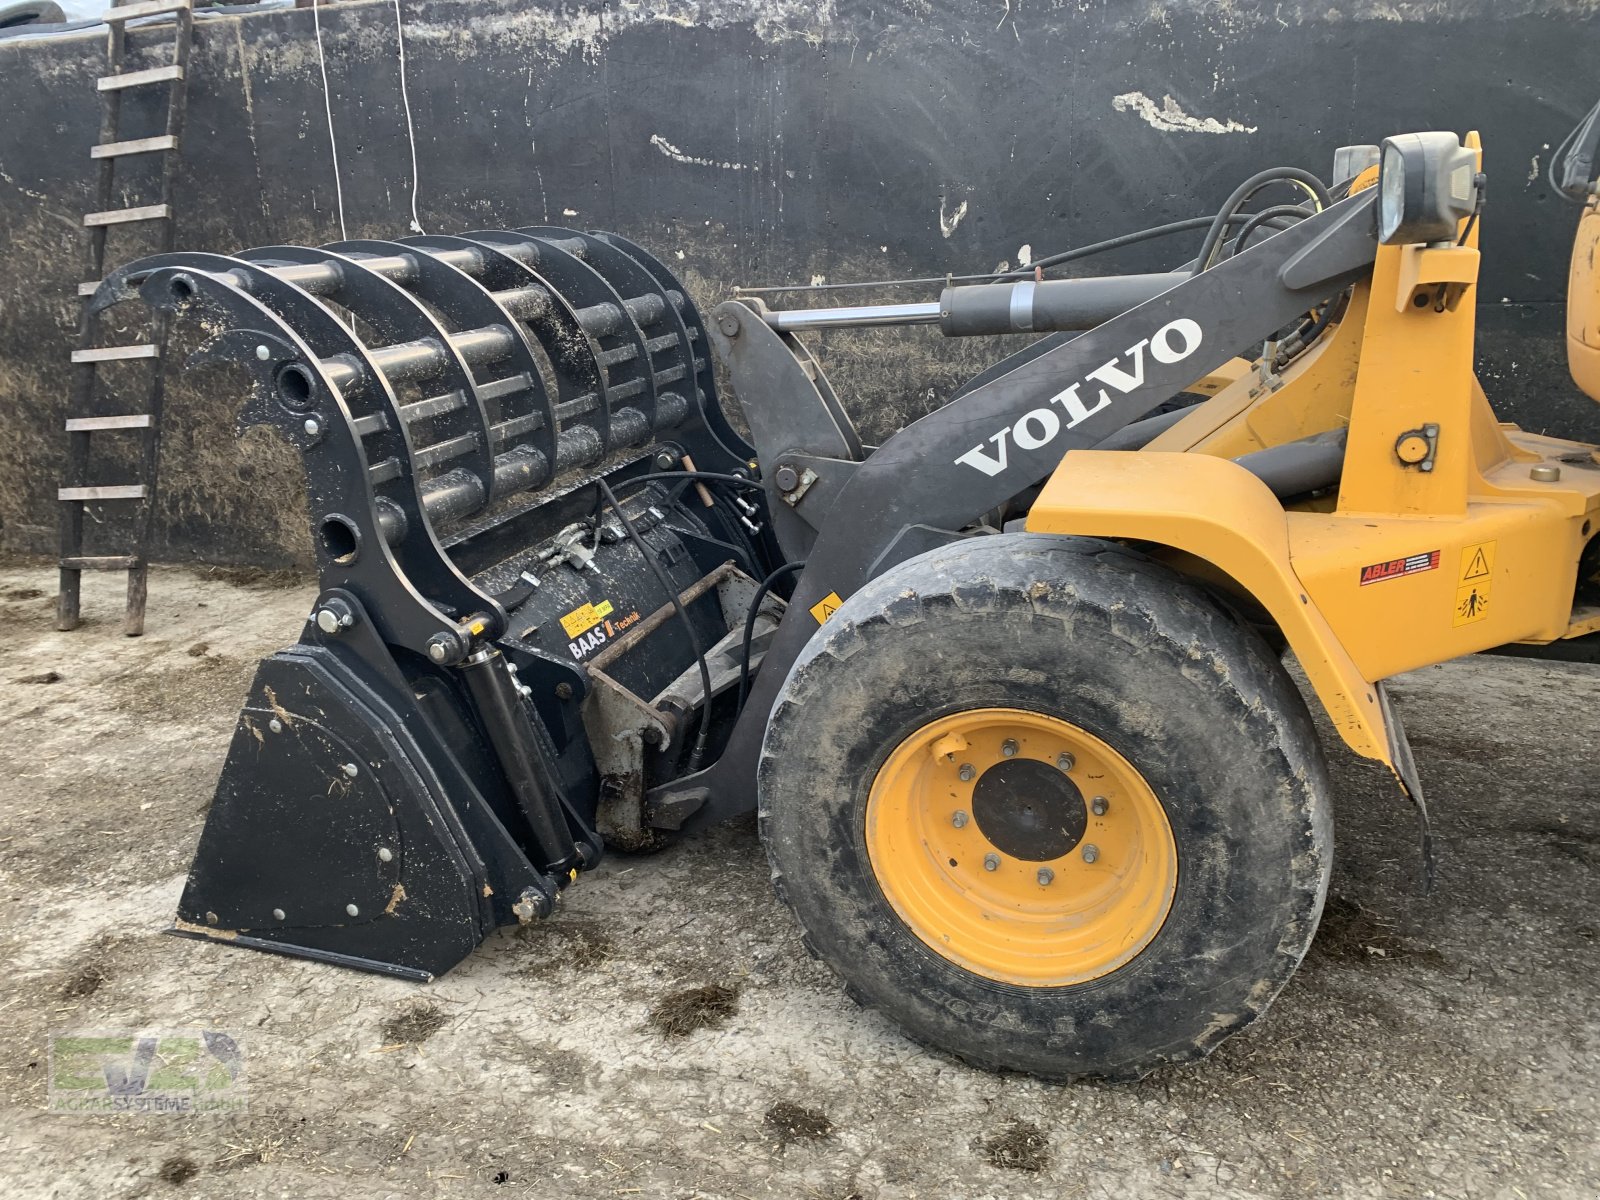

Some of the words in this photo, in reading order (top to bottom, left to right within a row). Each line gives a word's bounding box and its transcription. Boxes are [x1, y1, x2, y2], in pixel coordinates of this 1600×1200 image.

[953, 318, 1203, 477] VOLVO
[1362, 559, 1405, 580] ABLER
[568, 627, 605, 659] BAAS
[615, 611, 640, 630] Technik
